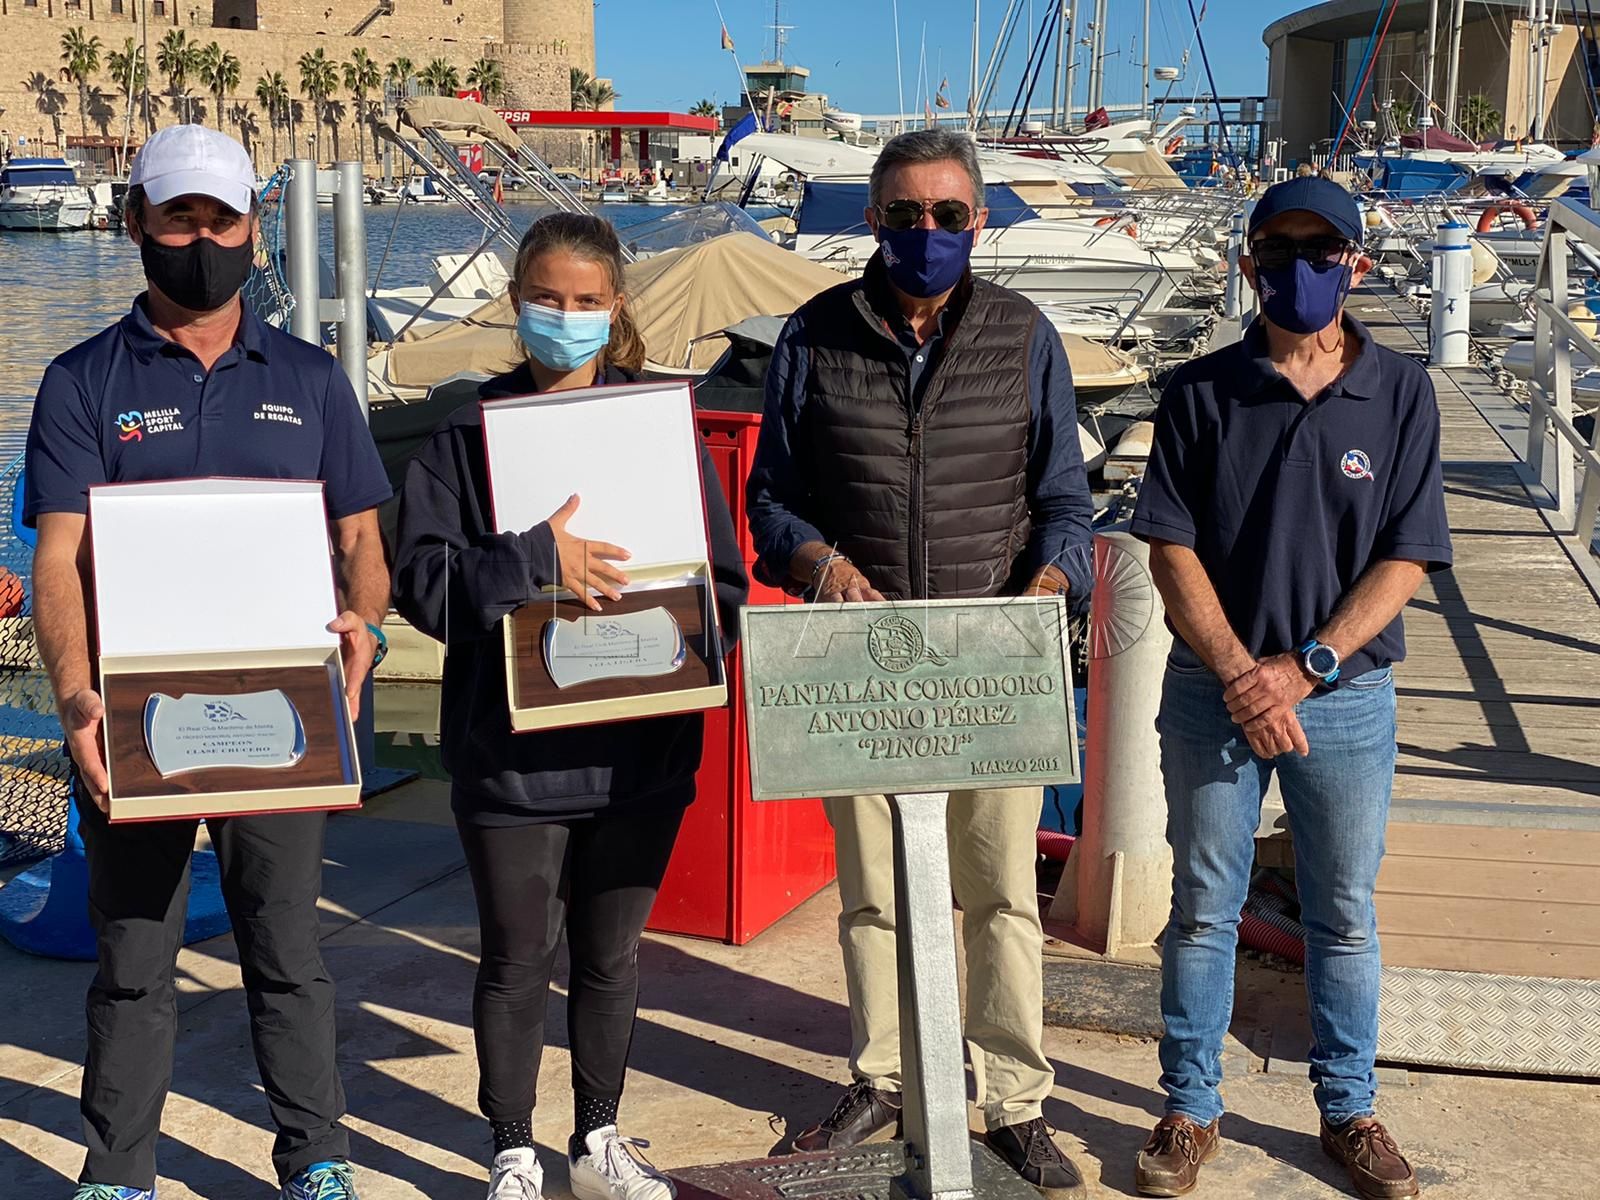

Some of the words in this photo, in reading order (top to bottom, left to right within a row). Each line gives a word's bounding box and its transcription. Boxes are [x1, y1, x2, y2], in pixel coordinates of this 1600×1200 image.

[144, 408, 181, 419] MELILLA
[262, 403, 294, 414] EQUIPO
[145, 416, 175, 427] SPORT
[253, 411, 266, 420] DE
[267, 411, 302, 426] REGATAS
[147, 422, 184, 434] CAPITAL
[760, 675, 898, 707] PANTALÁN
[903, 672, 1056, 701] COMODORO
[808, 708, 929, 734] ANTONIO
[933, 701, 1017, 728] PÉREZ
[970, 759, 1027, 775] MARZO
[1029, 756, 1061, 772] 2011
